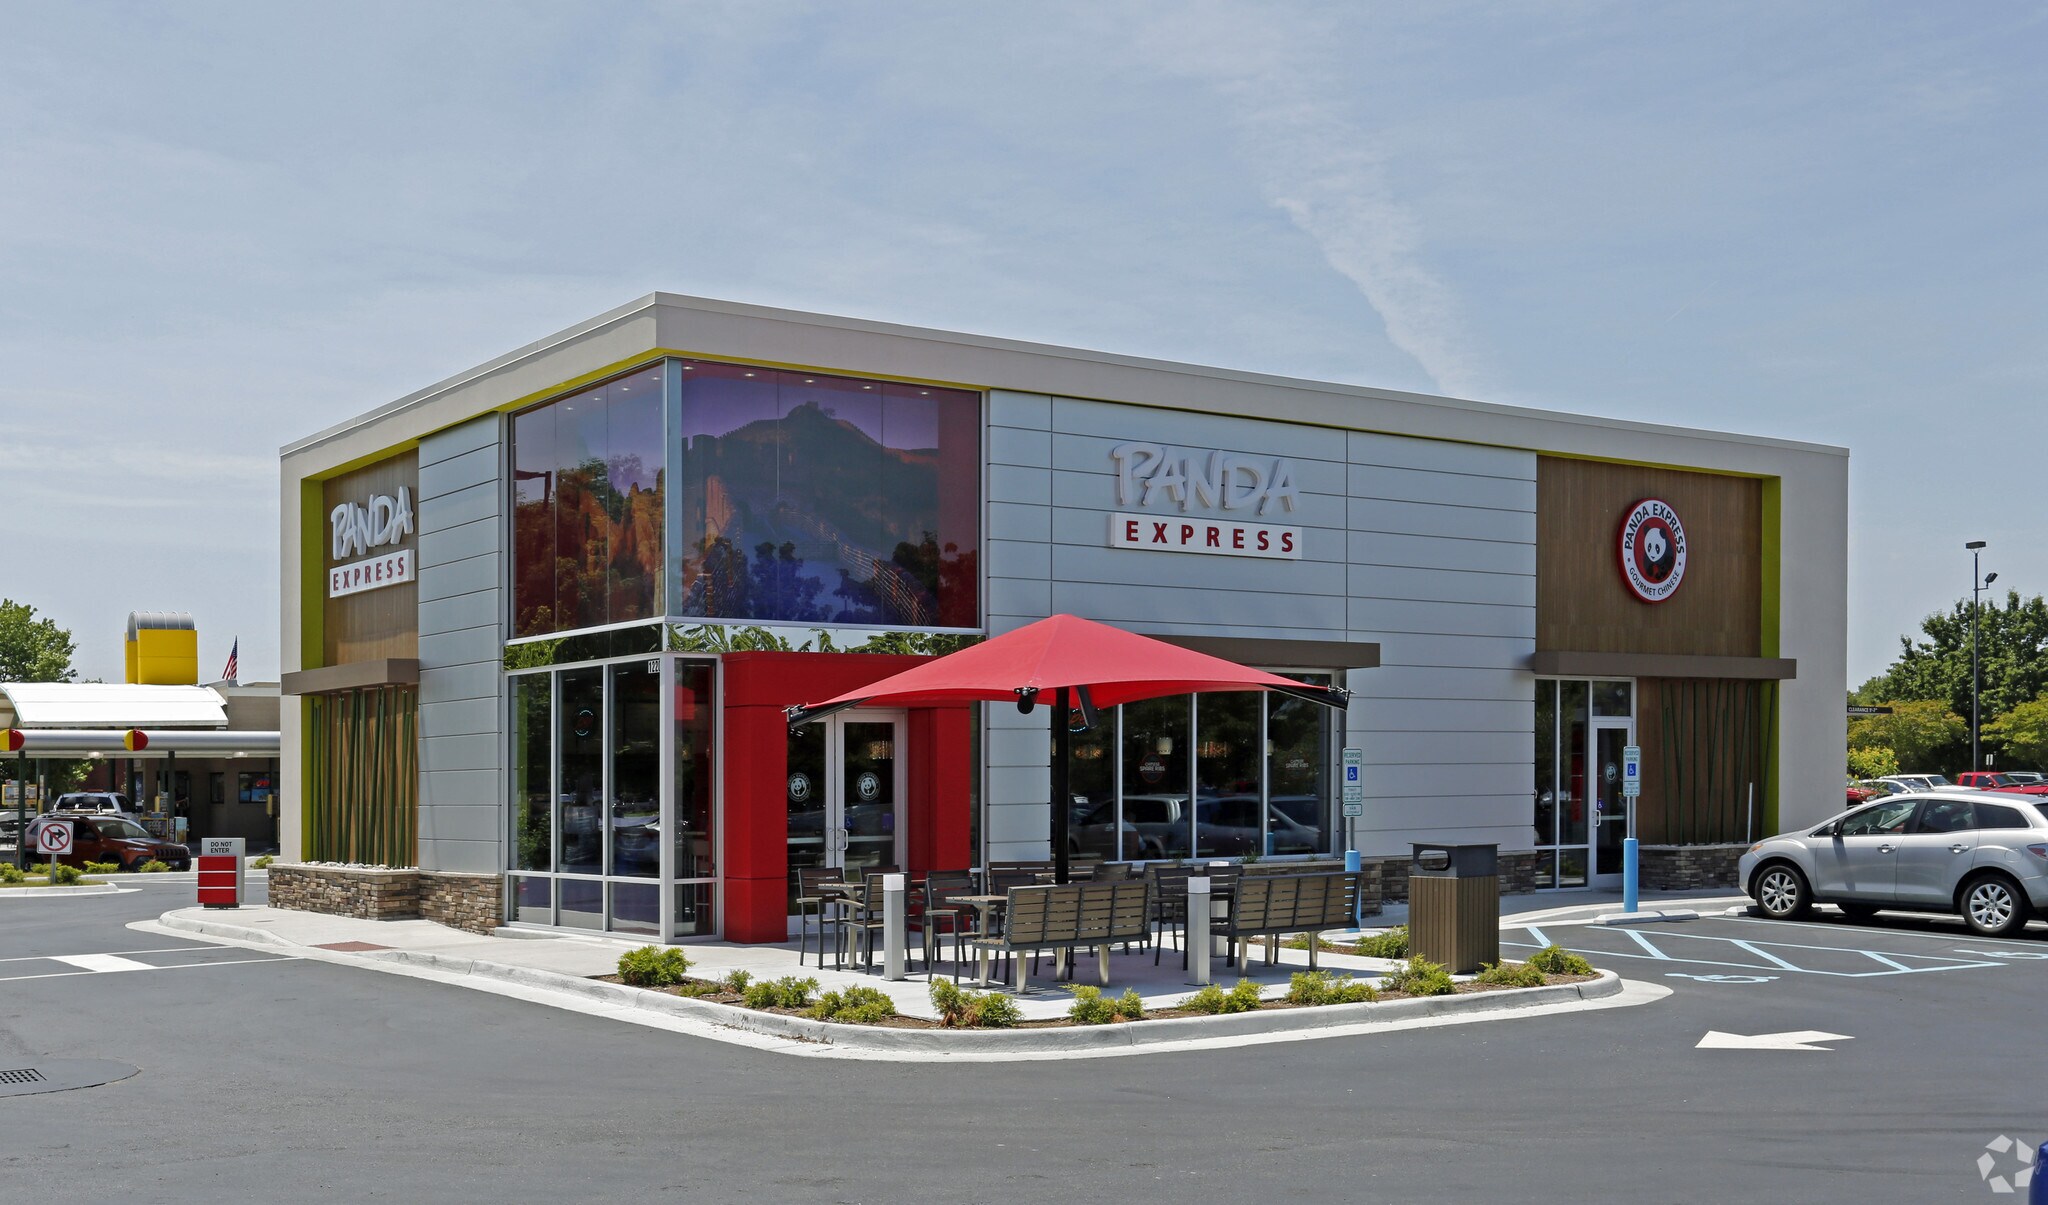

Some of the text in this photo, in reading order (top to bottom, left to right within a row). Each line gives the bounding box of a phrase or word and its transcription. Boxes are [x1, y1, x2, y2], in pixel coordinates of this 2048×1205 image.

[1111, 443, 1300, 515] PANDA
[330, 486, 413, 560] PANDA
[1126, 520, 1293, 552] EXPRESS
[1624, 504, 1684, 554] PANDA EXPRESS
[333, 557, 404, 591] EXPRESS
[1629, 567, 1680, 596] GOURMET CHINESE
